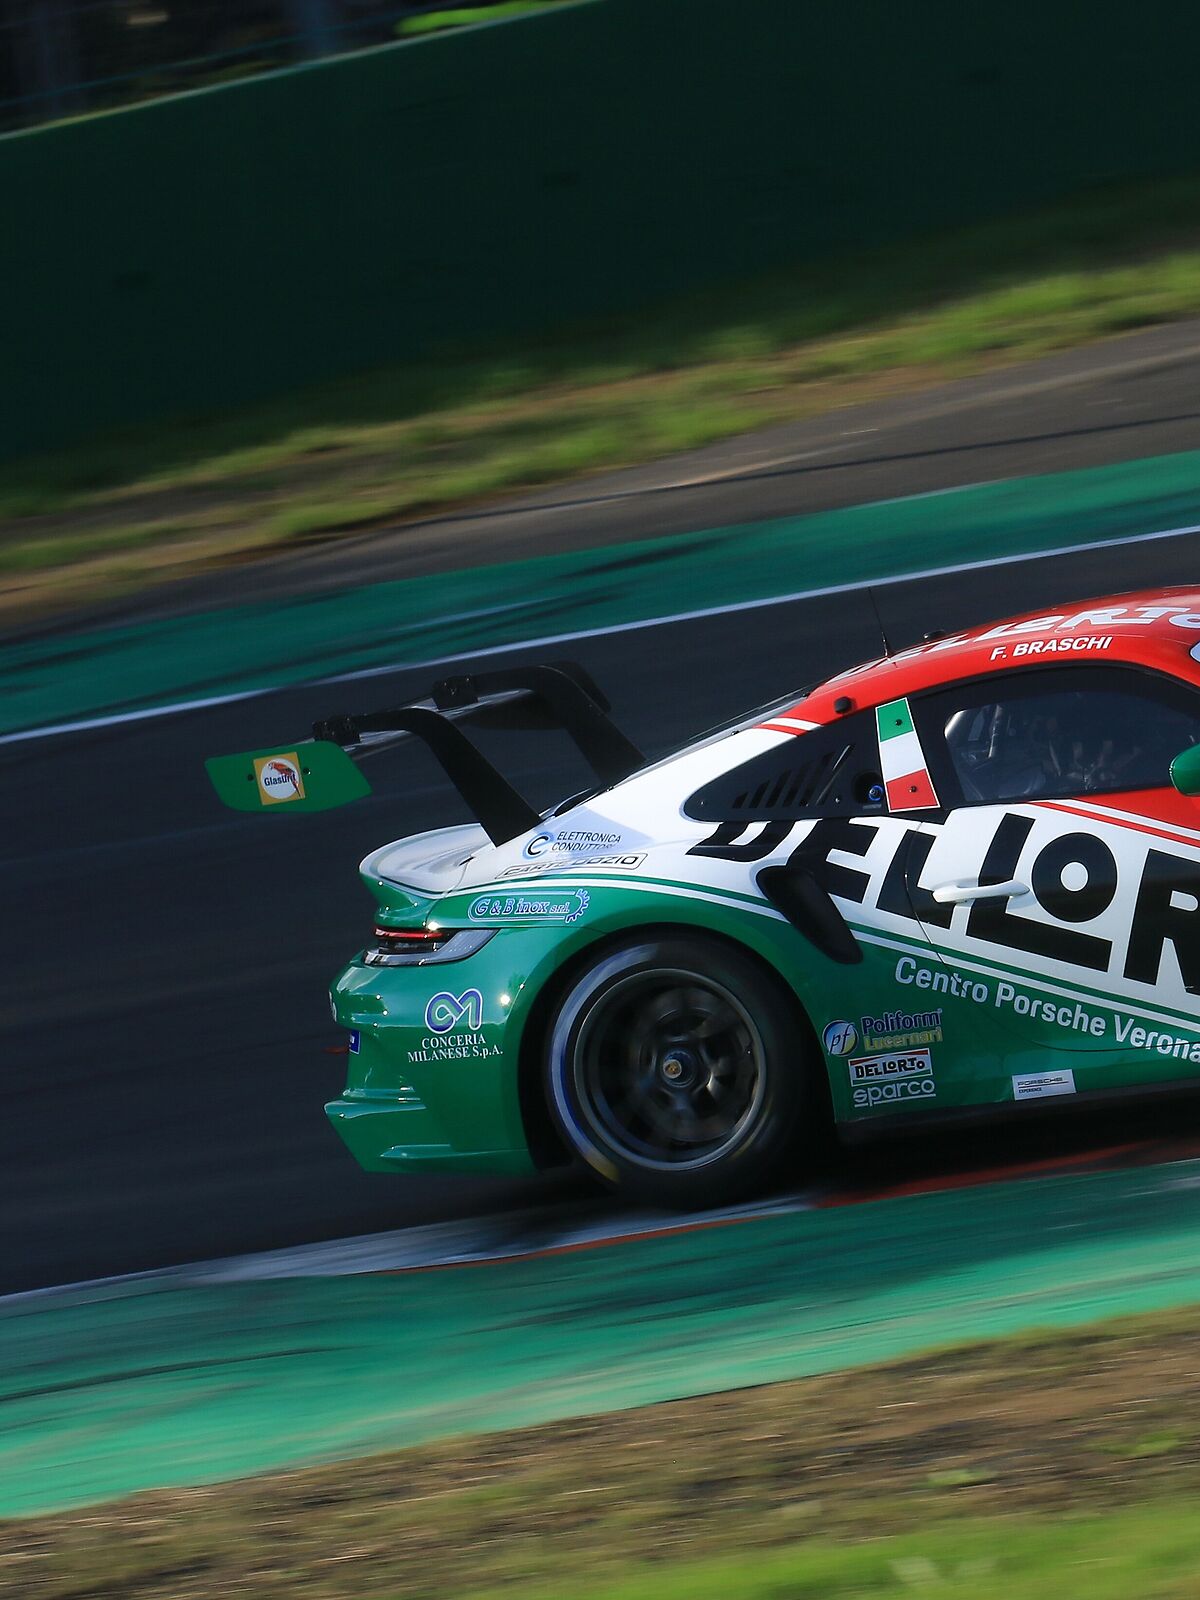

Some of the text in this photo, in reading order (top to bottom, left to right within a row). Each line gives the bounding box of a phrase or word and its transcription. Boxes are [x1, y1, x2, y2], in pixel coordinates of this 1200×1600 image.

[990, 636, 1113, 661] F. BRASCHI
[557, 831, 622, 843] ELETTRONICA
[475, 898, 491, 915] G
[490, 900, 502, 915] &
[502, 898, 516, 915] B
[895, 957, 988, 1003] Centro
[994, 982, 1106, 1036] Porsche
[421, 1033, 486, 1050] CONCERIA
[407, 1044, 503, 1063] MILANESE S.p.A.
[855, 1057, 926, 1079] DELLORTO
[1017, 1077, 1064, 1087] PORSCHE
[853, 1079, 936, 1107] sparco
